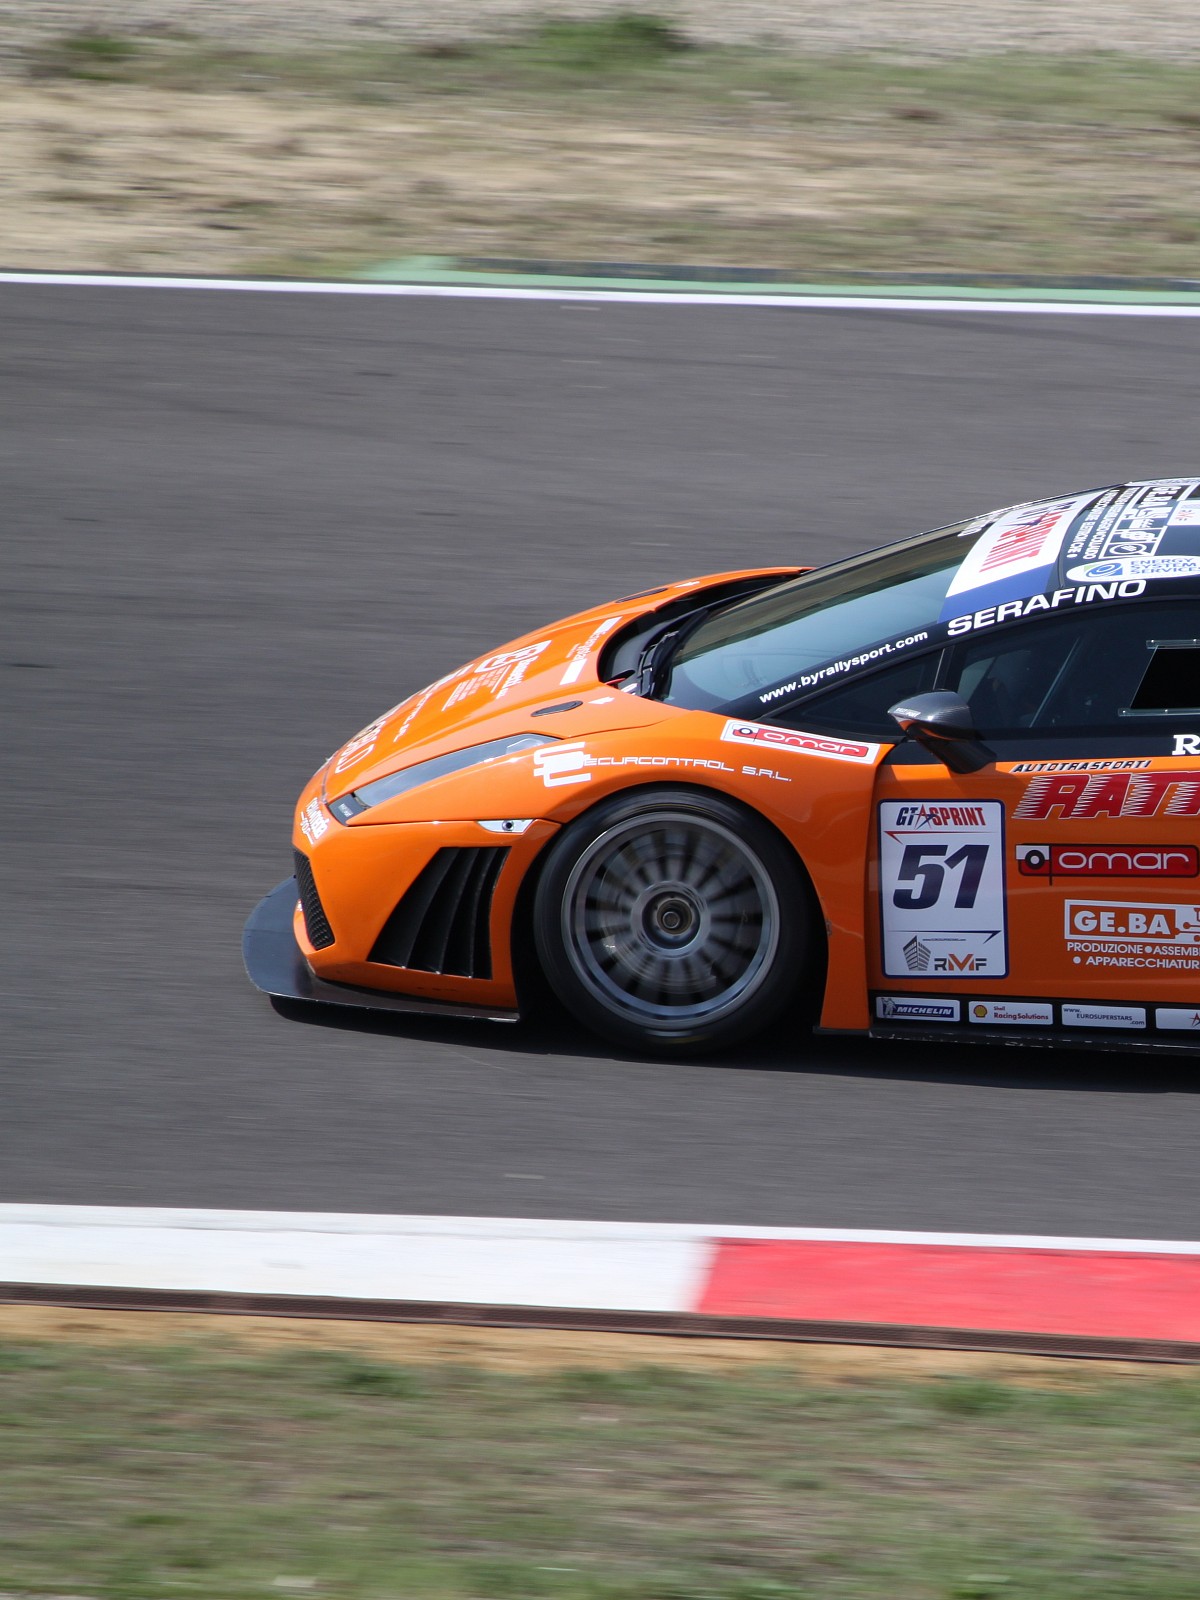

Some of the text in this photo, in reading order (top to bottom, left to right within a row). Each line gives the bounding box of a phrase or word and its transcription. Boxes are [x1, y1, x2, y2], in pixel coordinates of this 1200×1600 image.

[947, 579, 1147, 637] SERAFINO
[758, 630, 929, 704] www.byrallysport.com
[762, 731, 862, 755] omar
[741, 765, 793, 782] S.R.L.
[1012, 760, 1152, 773] AUTOTRASPORTI
[1058, 852, 1190, 870] omar
[892, 844, 990, 910] 51
[1073, 910, 1171, 935] GE.BA
[1067, 941, 1144, 954] PRODUZIONE
[934, 953, 987, 972] RMF
[897, 1005, 953, 1016] MICHELIN
[1076, 1013, 1133, 1021] EUROSUPERSTARS
